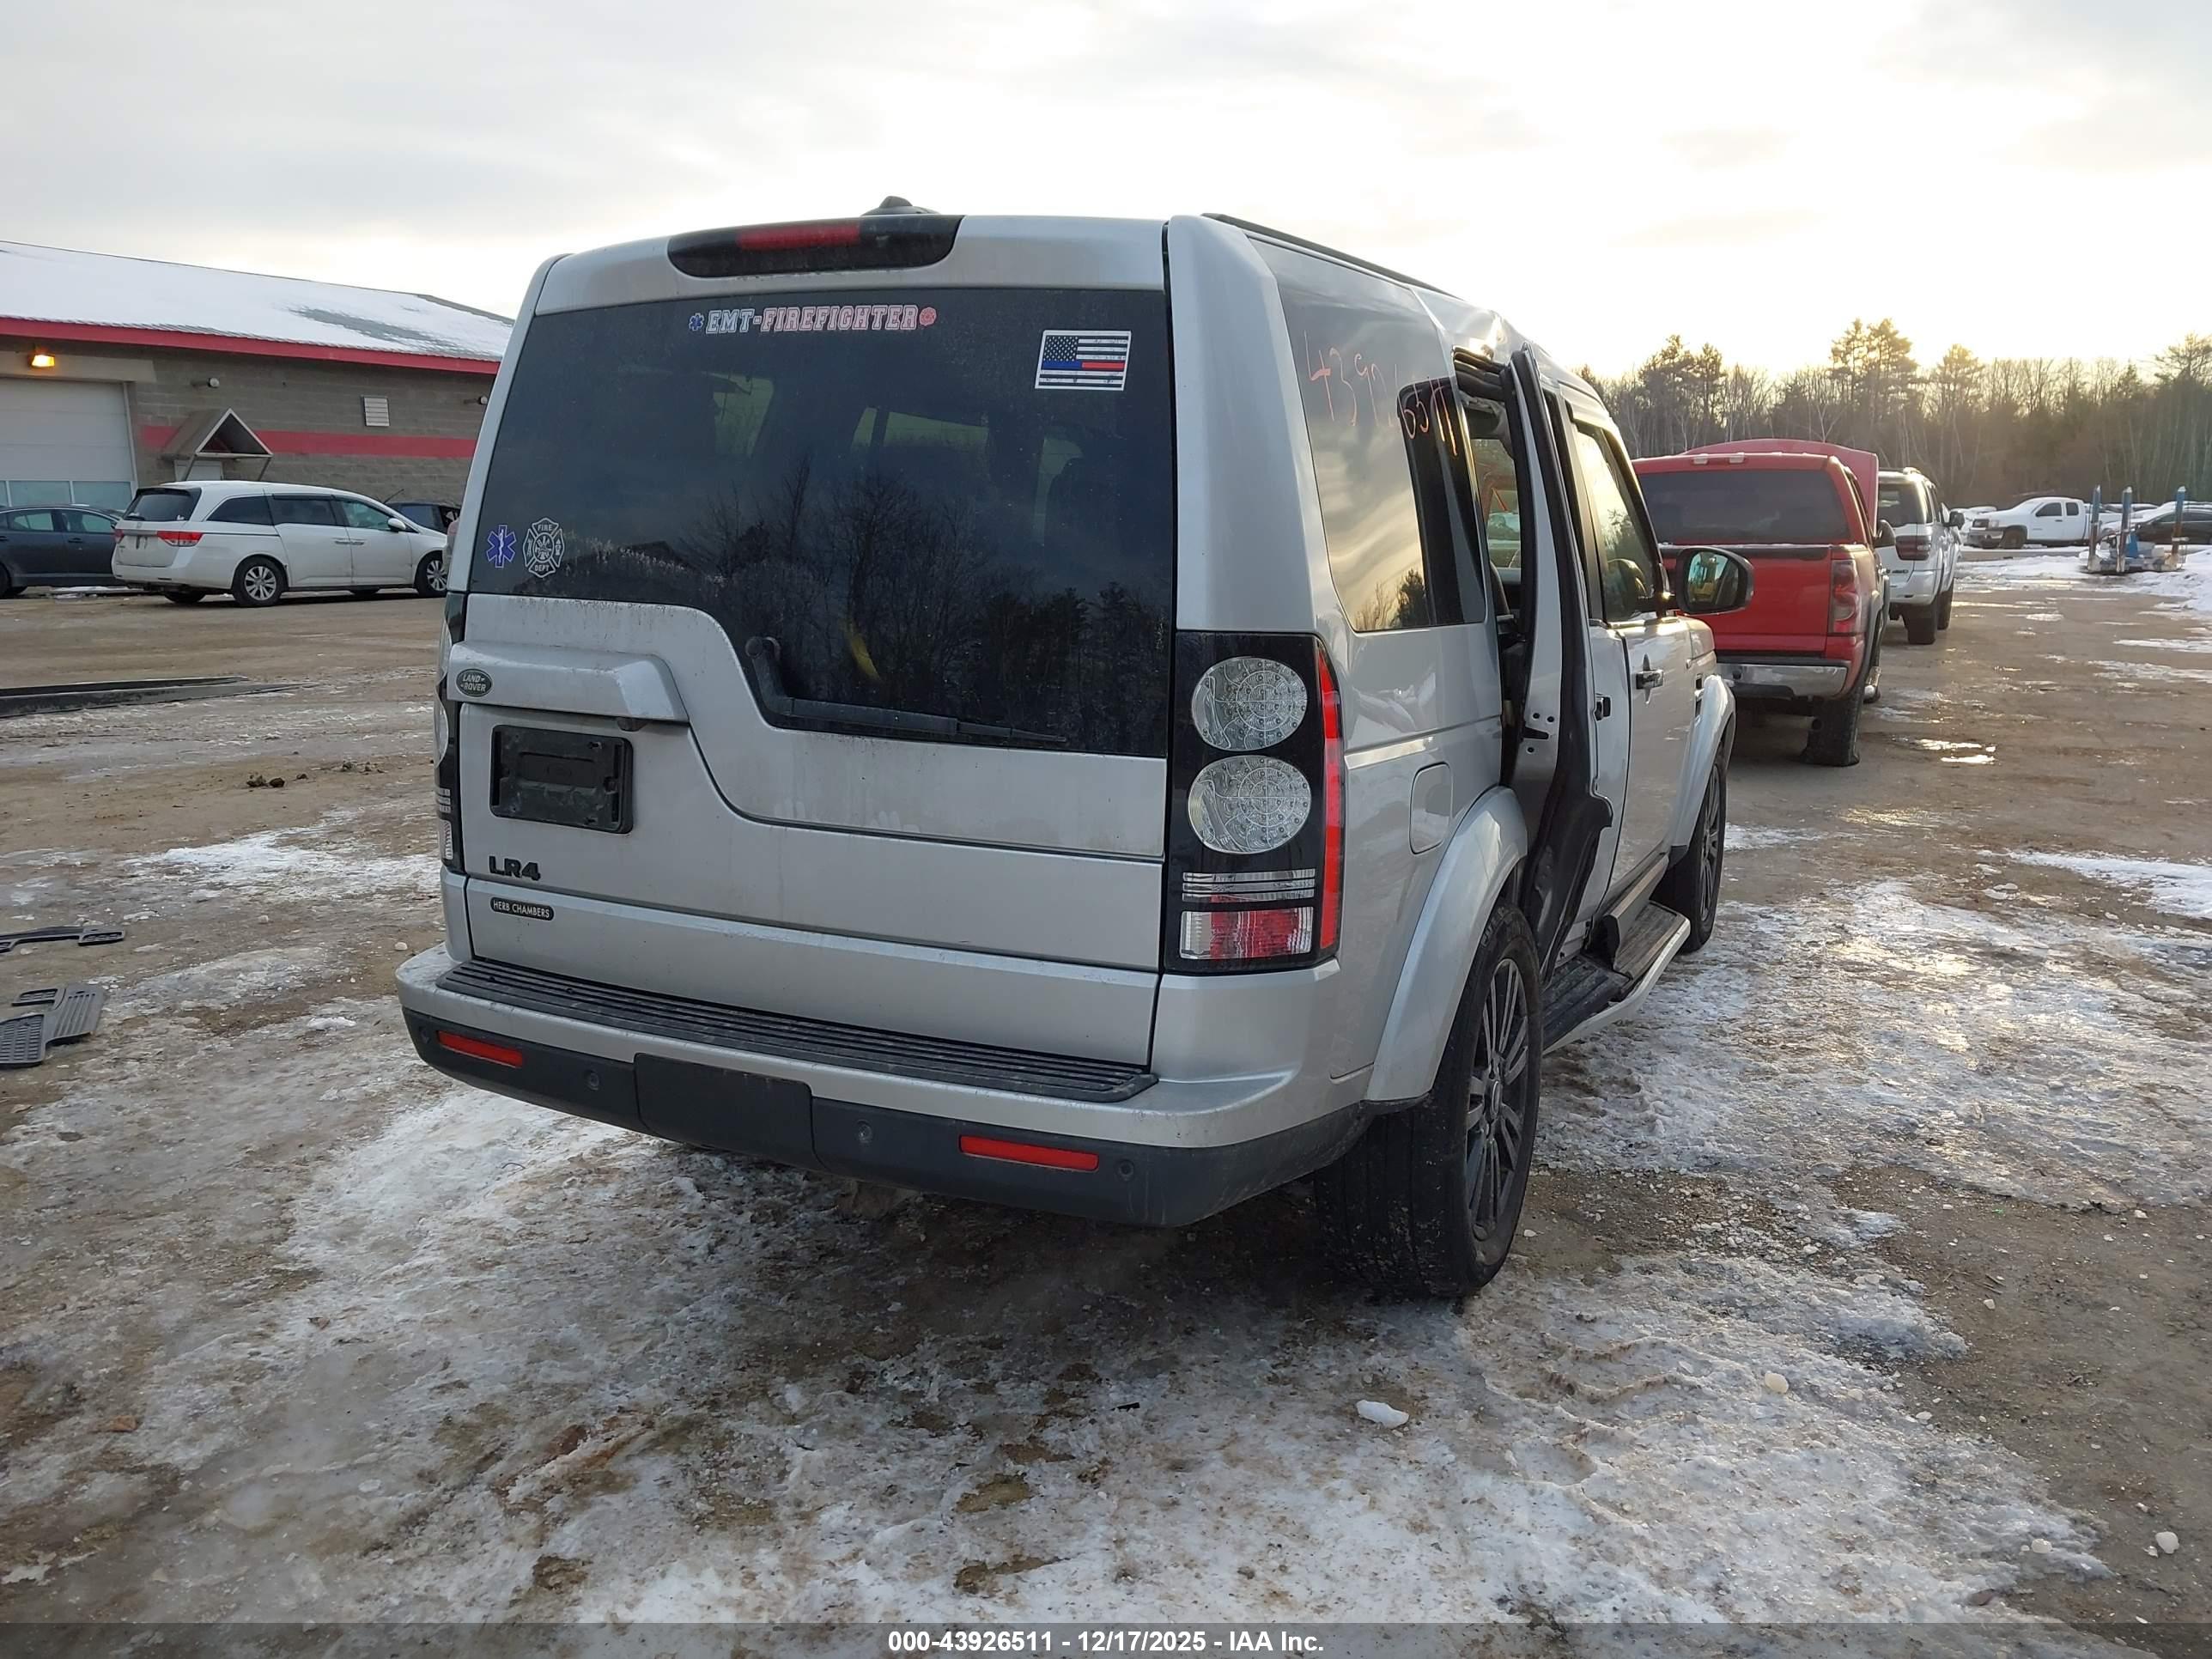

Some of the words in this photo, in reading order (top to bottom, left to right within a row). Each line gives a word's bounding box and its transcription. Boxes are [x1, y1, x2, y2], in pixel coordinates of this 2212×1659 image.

[705, 304, 919, 334] EMT-FIREFIGHTER
[462, 673, 482, 684] LAND
[464, 682, 487, 692] ROVER
[489, 856, 540, 881] LR4
[494, 901, 510, 911] HERB
[513, 903, 550, 918] CHAMBERS
